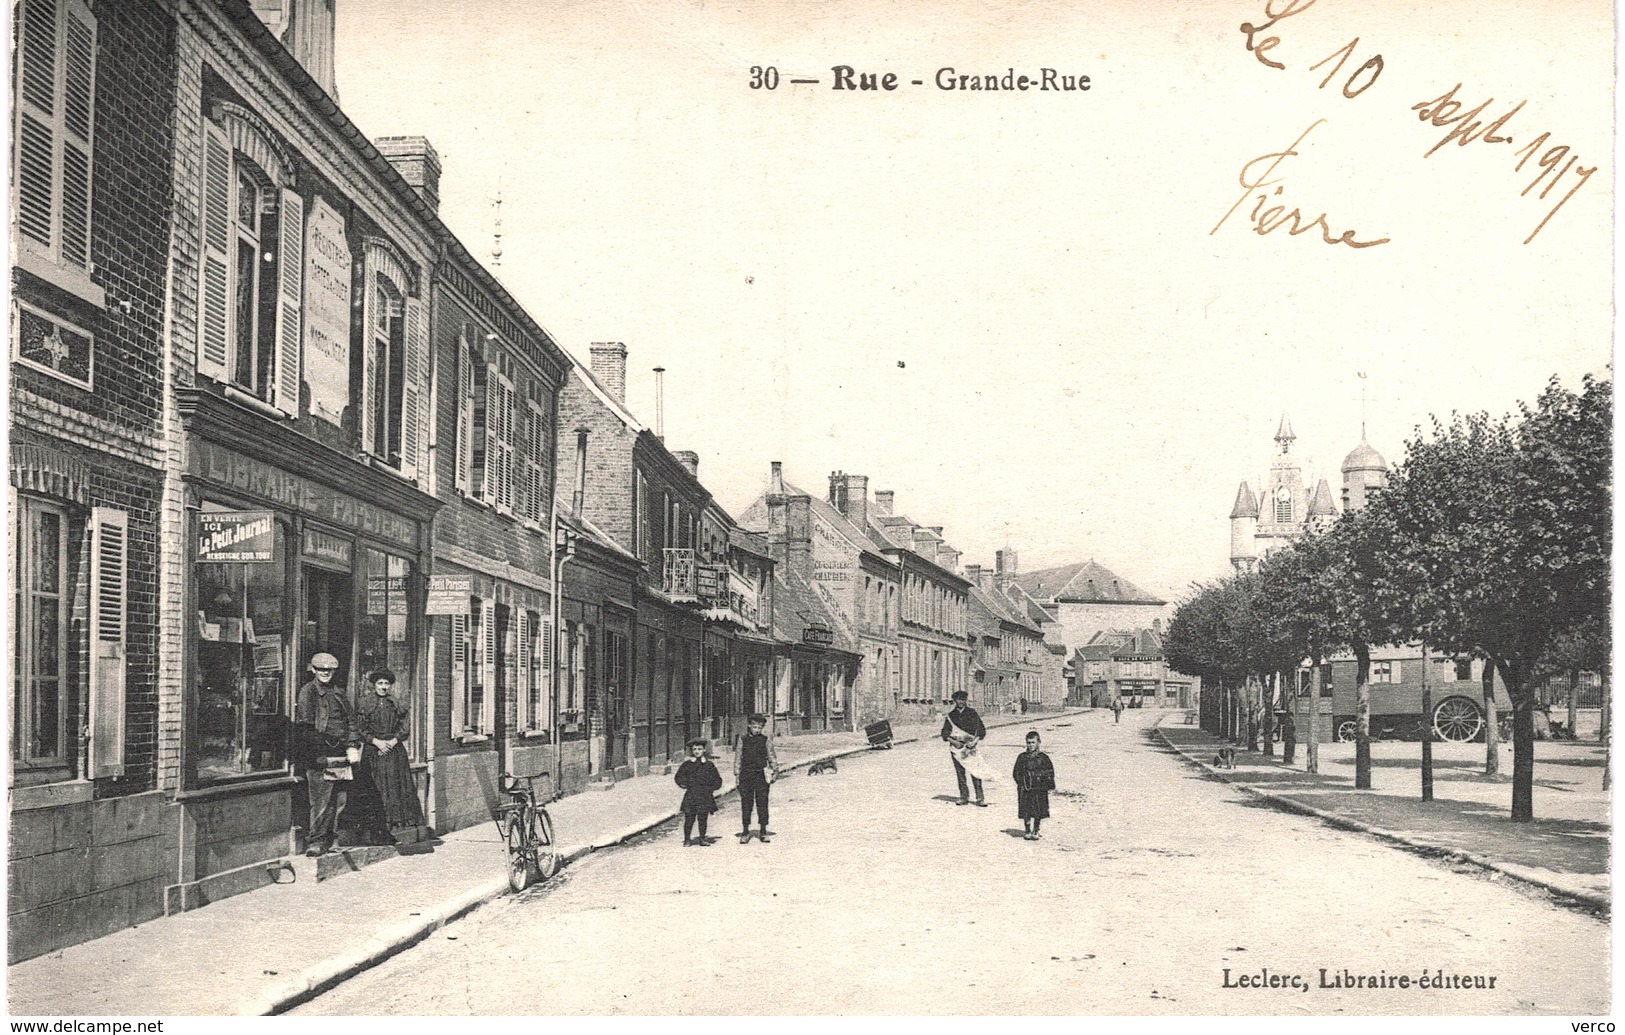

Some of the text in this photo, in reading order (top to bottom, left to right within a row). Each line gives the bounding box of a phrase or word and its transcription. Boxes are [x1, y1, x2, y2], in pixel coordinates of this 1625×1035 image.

[749, 65, 780, 91] 30
[831, 65, 898, 91] Rue
[935, 67, 1091, 92] Grande-Rue
[1309, 37, 1384, 99] 10
[208, 444, 412, 544] LIBRAIRIE PAPETERIE
[200, 514, 241, 522] EN VENTE
[204, 522, 222, 531] ICI
[199, 514, 271, 555] Le Petit Journal
[241, 551, 254, 560] SUR
[255, 551, 271, 560] TOUT
[1221, 968, 1497, 993] Leclerc, Libraire-éditeur
